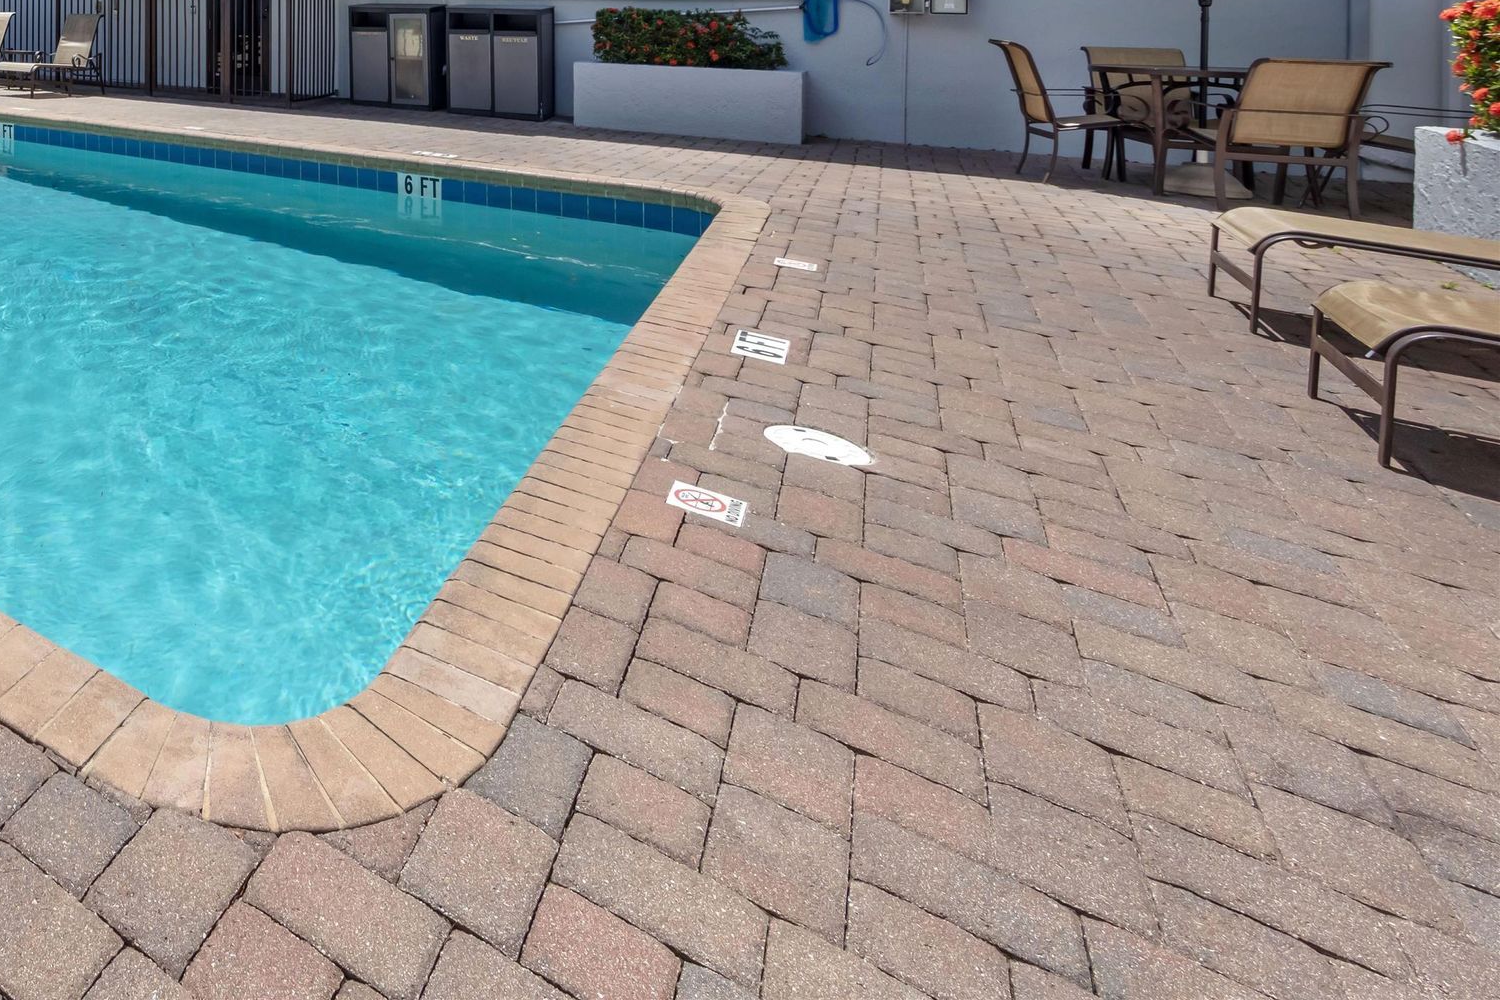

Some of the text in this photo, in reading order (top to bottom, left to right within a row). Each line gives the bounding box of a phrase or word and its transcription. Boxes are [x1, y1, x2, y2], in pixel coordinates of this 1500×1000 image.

[2, 124, 13, 139] FT
[404, 175, 440, 198] 6 FT
[736, 331, 786, 359] 6 FT
